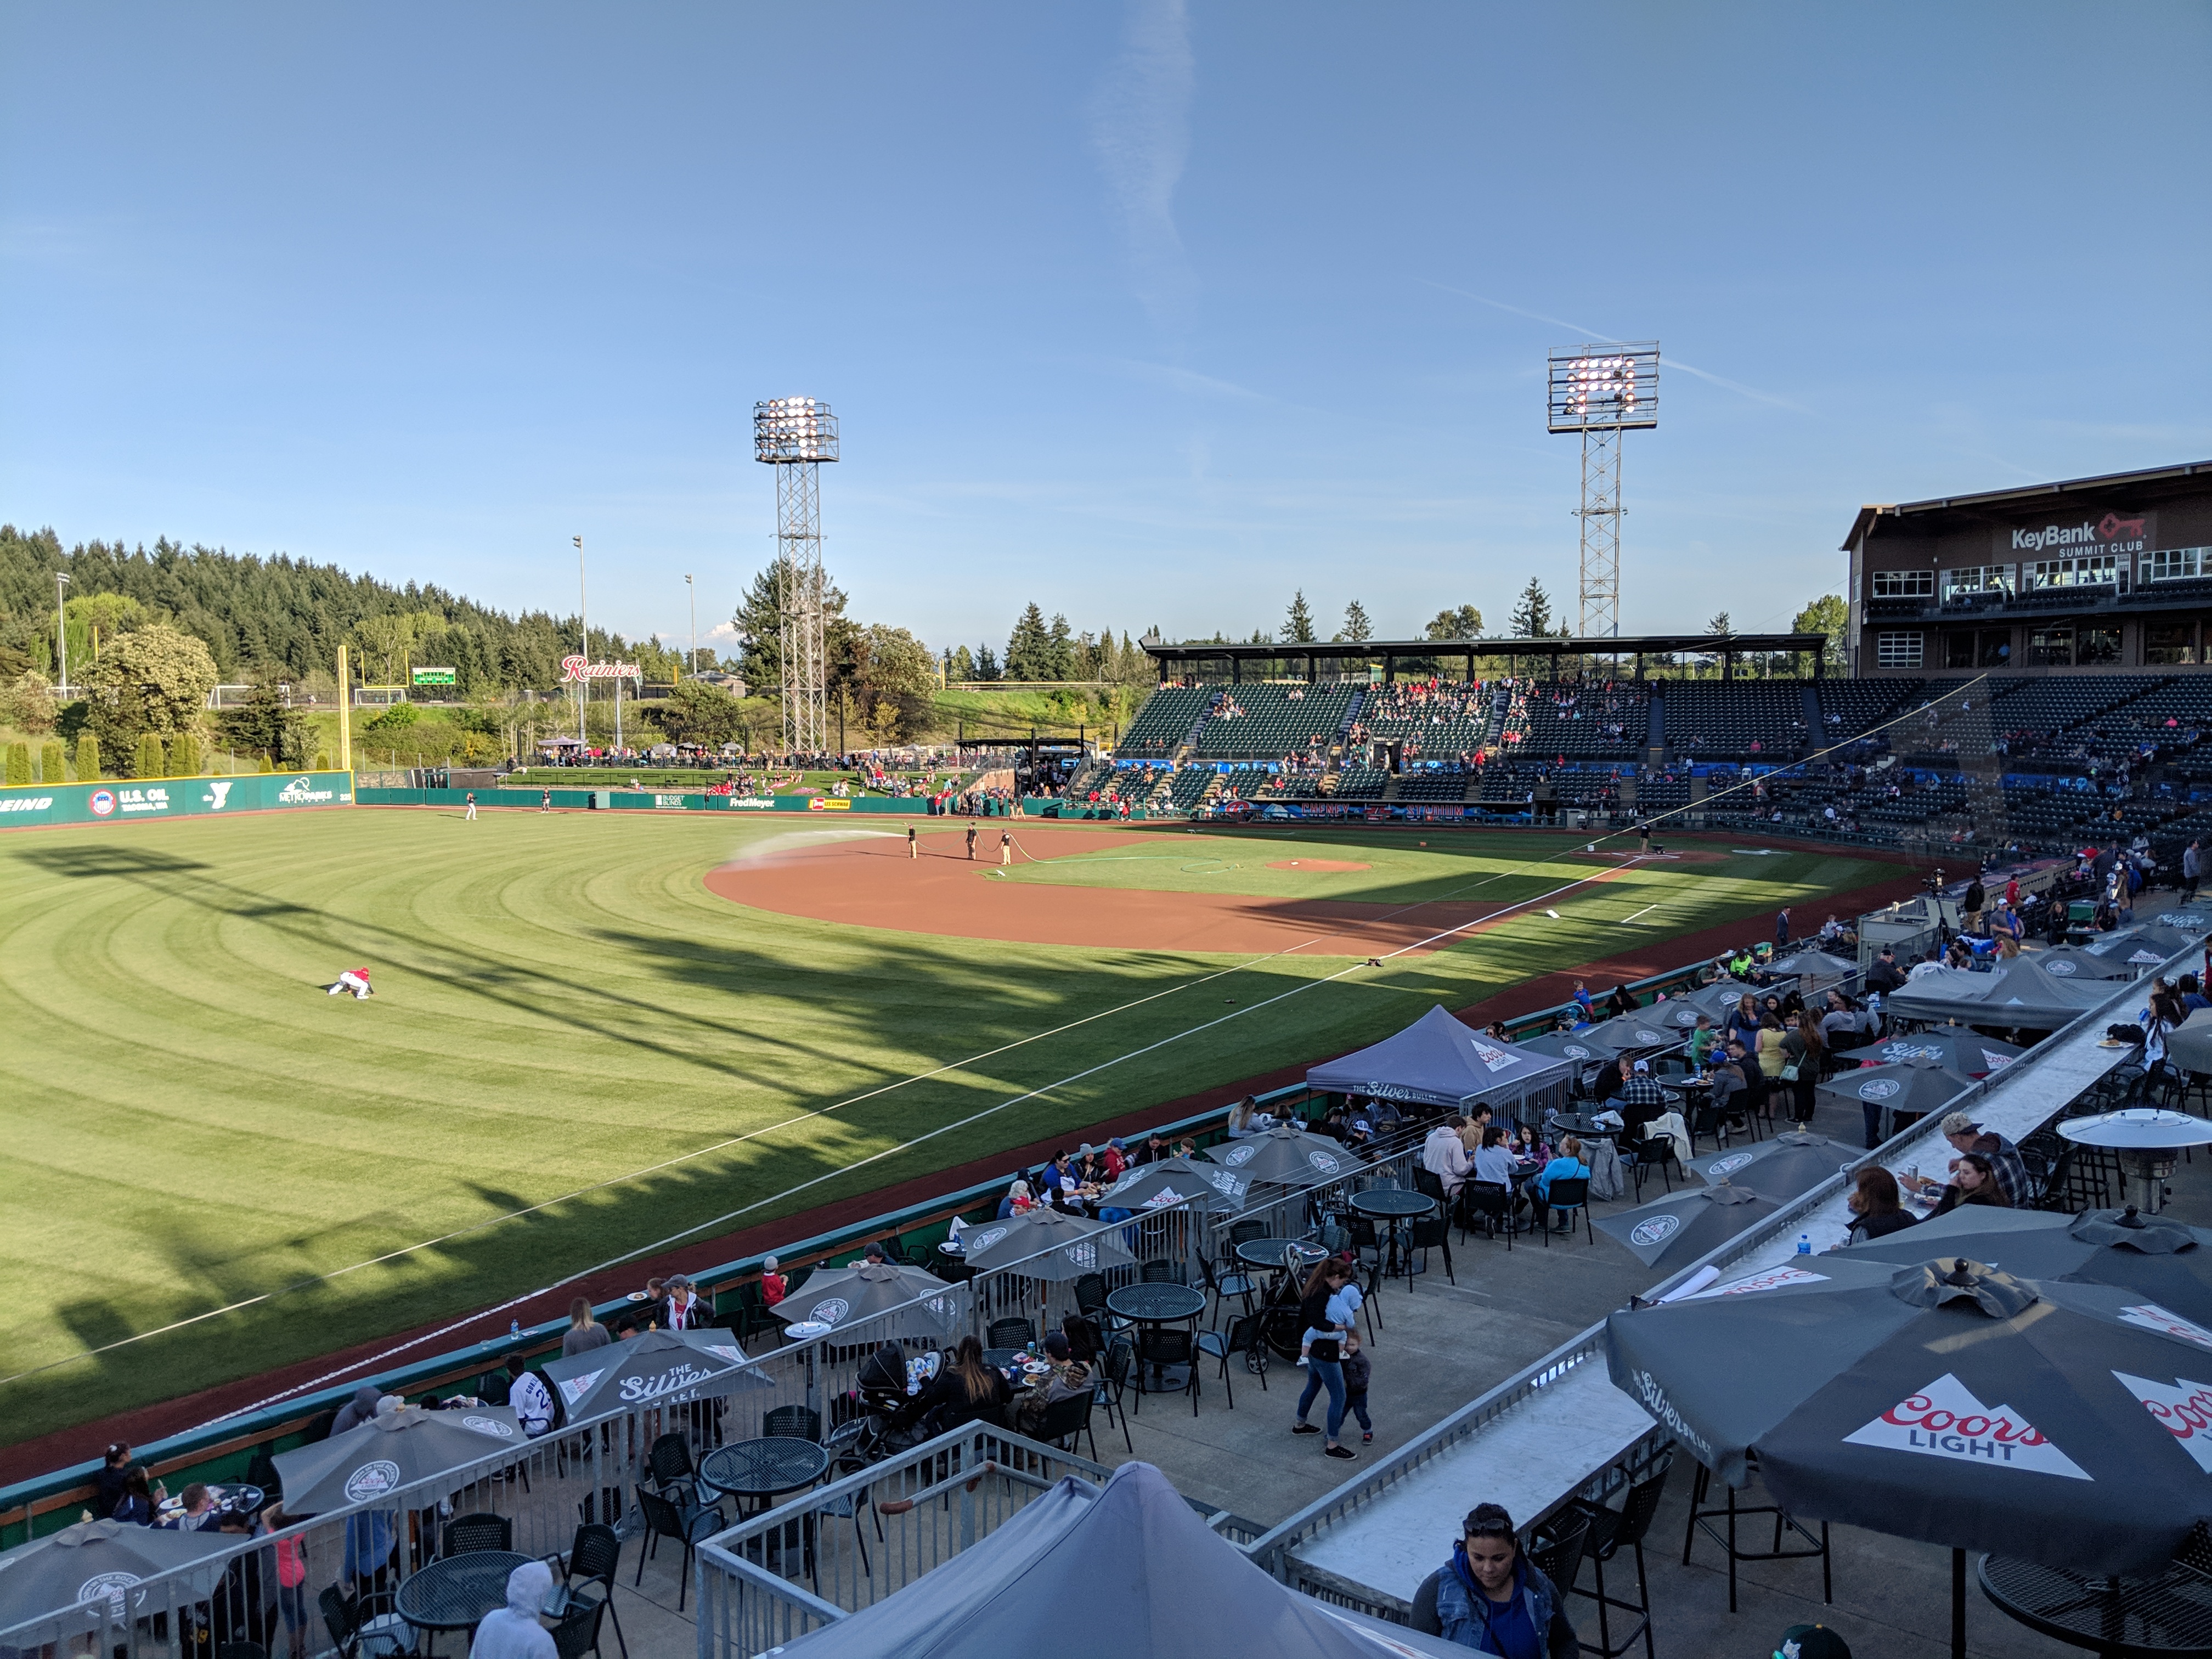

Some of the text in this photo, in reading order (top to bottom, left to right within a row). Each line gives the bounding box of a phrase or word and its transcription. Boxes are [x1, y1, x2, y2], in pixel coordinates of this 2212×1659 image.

[2012, 522, 2096, 551] KeyBank
[2059, 540, 2143, 558] SUMMIT CLUB
[560, 655, 640, 682] Rainiers
[0, 797, 53, 812] EING
[119, 789, 145, 803] U.S.
[147, 788, 170, 801] OIL
[1301, 803, 1464, 816] CHENEY STADIUM
[1477, 1049, 1506, 1063] Coors
[1492, 1057, 1510, 1067] LIGHT
[1353, 1081, 1437, 1102] THE Silver BULLET
[669, 1363, 691, 1376] THE
[1641, 1370, 1684, 1433] Silver
[1880, 1393, 2050, 1446] Coors
[1909, 1429, 2017, 1460] LIGHT
